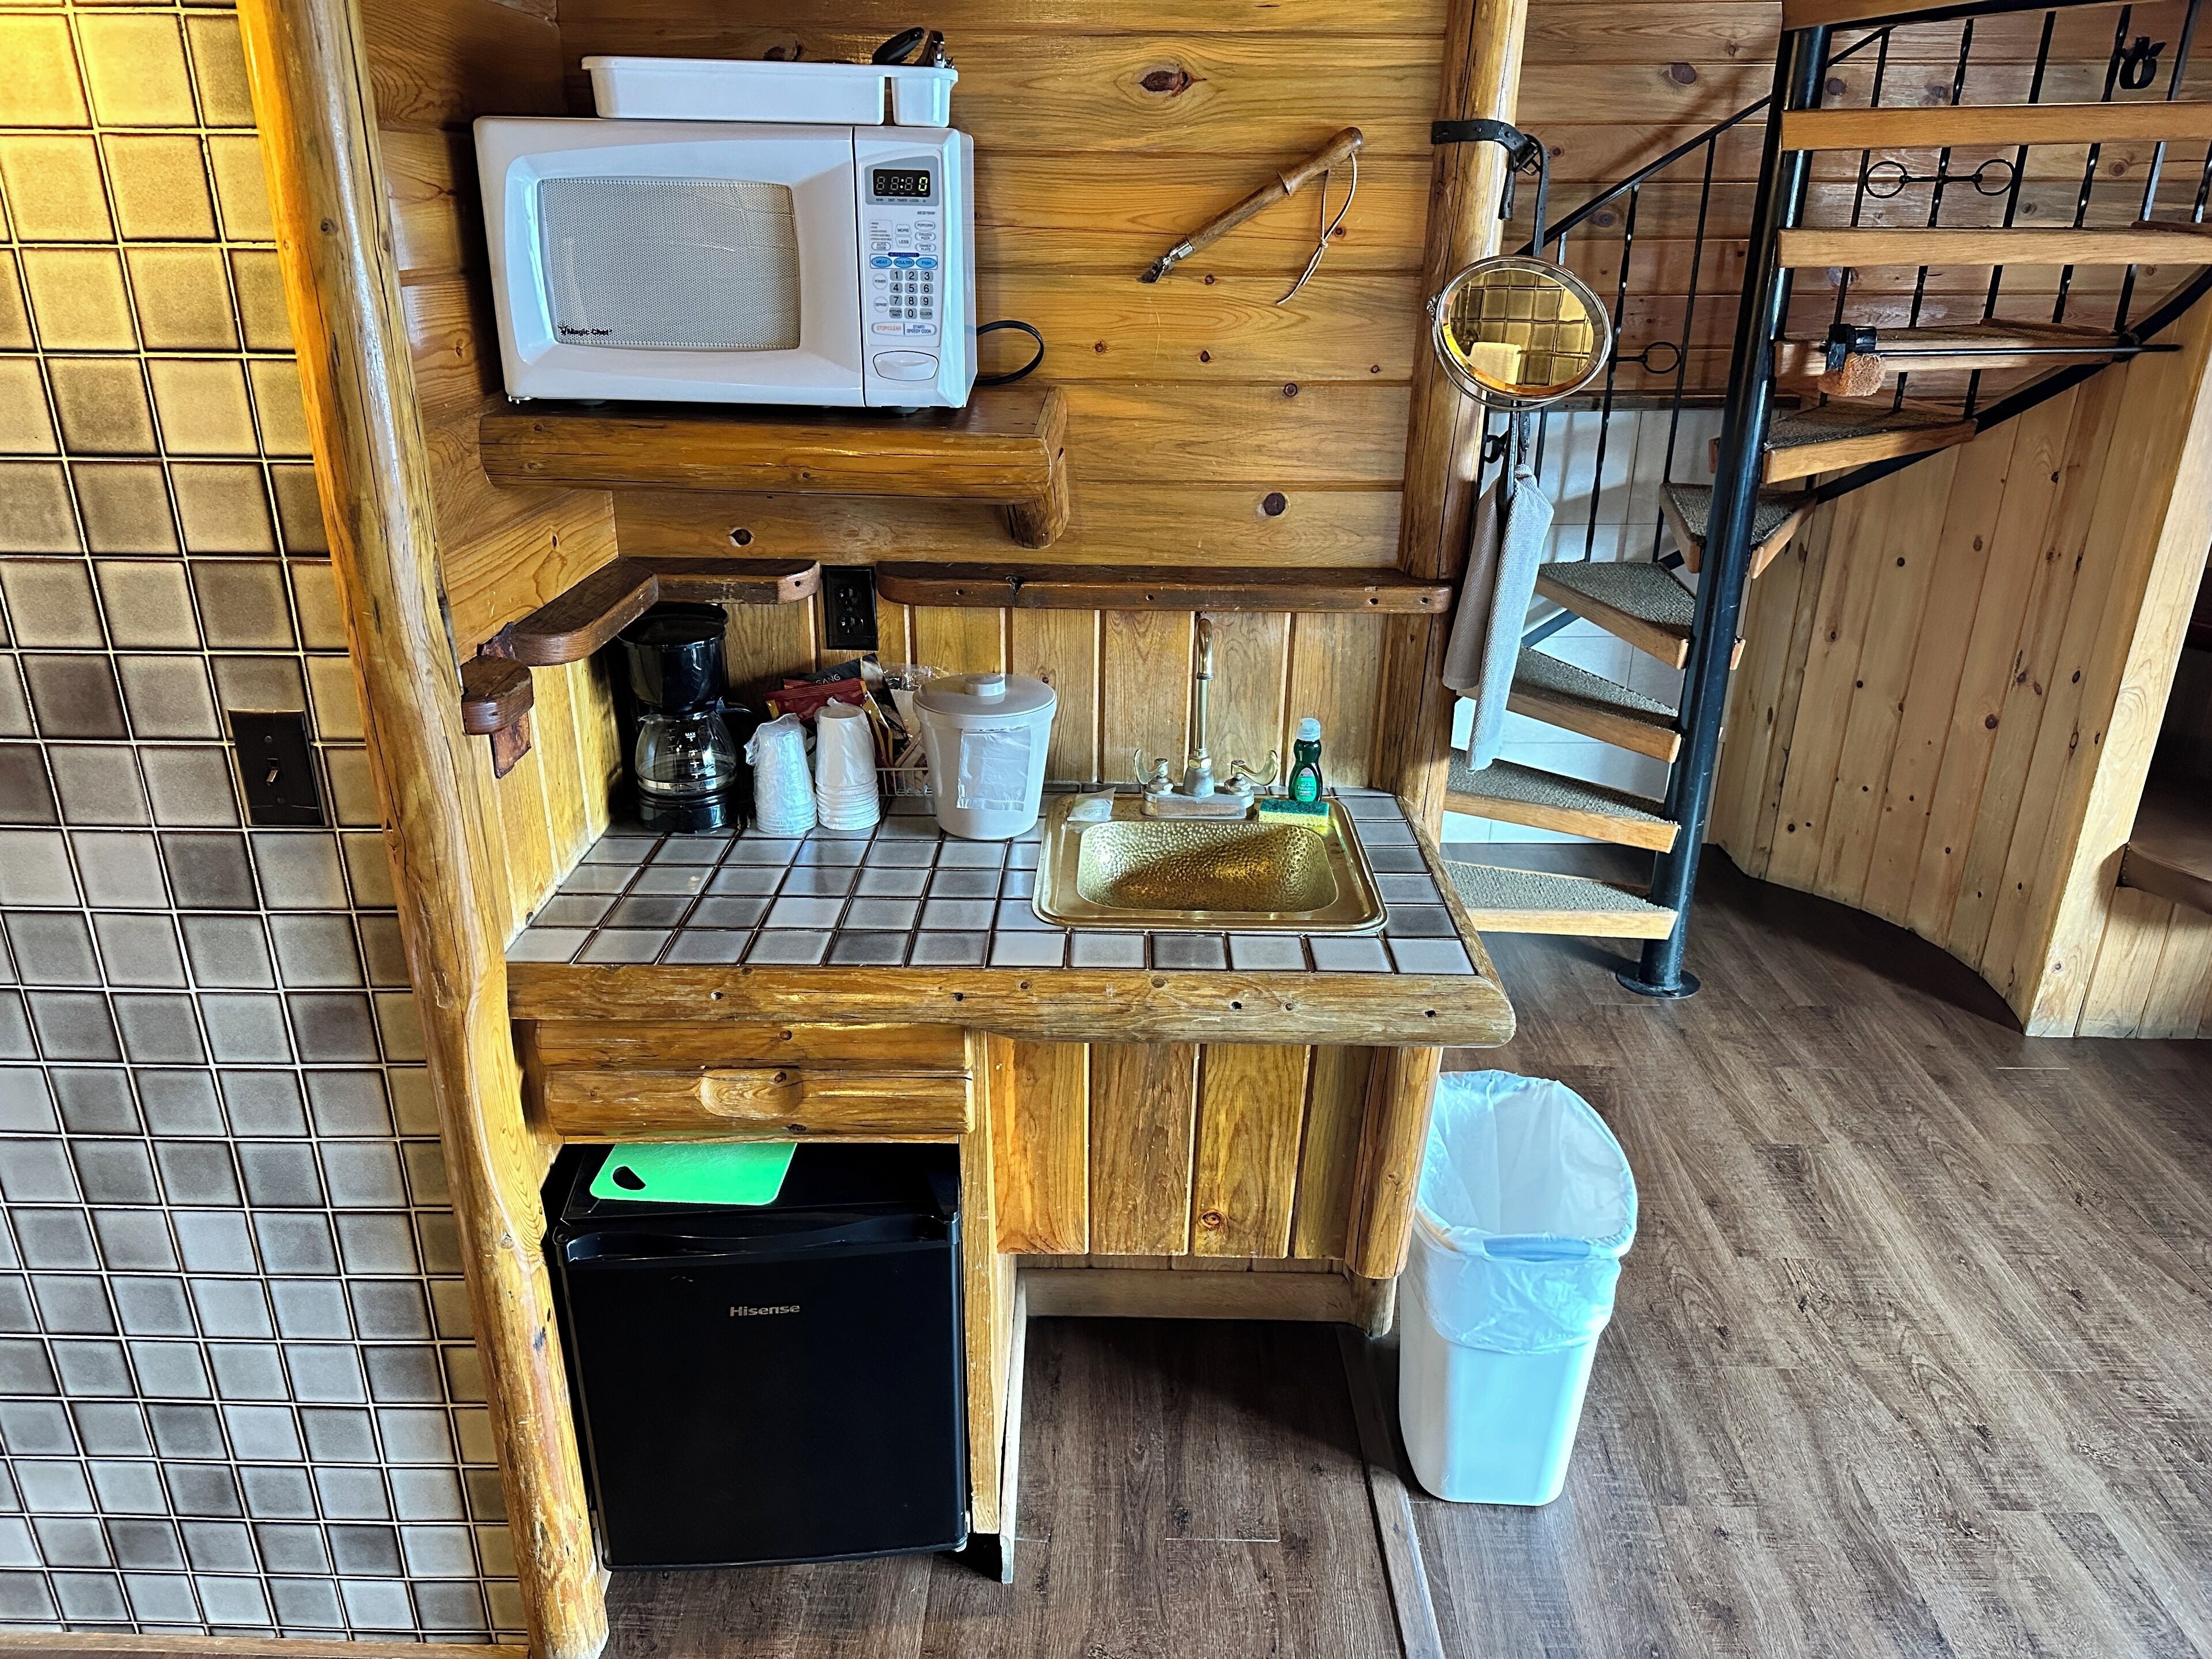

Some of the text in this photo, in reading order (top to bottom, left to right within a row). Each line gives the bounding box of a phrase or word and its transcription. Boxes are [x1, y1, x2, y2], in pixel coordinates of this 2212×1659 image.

[894, 271, 898, 279] 1
[908, 271, 915, 280] 2
[924, 271, 930, 281] 3
[893, 283, 899, 292] 4
[908, 284, 915, 293] 5
[923, 284, 929, 293] 6
[893, 296, 899, 305] 7
[908, 297, 914, 305] 8
[923, 297, 929, 305] 9
[907, 309, 914, 317] 0
[567, 328, 590, 336] Magic
[729, 1305, 801, 1317] Hisense
